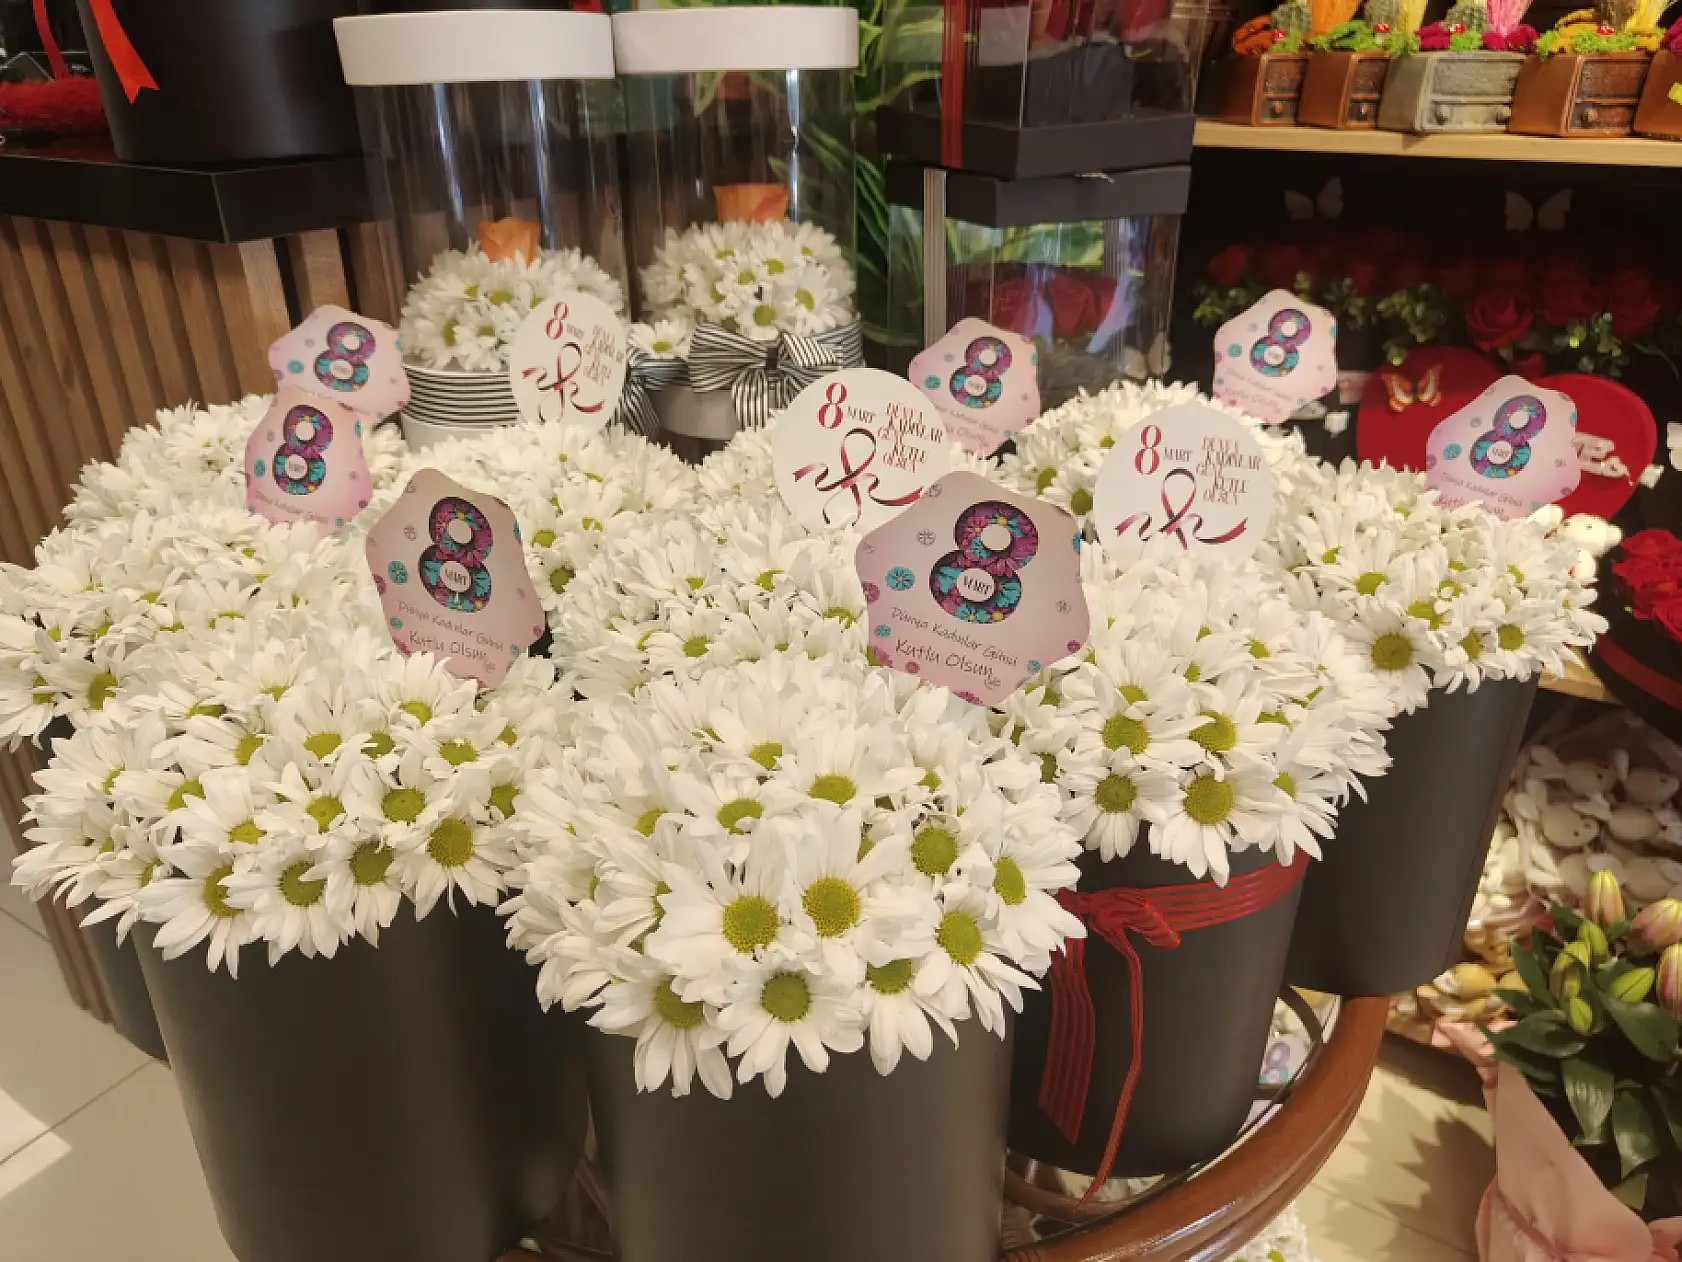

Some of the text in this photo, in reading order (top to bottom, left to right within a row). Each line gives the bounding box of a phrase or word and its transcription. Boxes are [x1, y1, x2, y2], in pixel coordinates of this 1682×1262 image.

[546, 302, 568, 340] 8
[1250, 309, 1311, 377] 8
[313, 321, 376, 393] 8
[950, 336, 1012, 408] 8
[817, 382, 847, 429] 8
[1469, 395, 1546, 479] 8
[272, 404, 333, 495] 8
[1134, 425, 1193, 475] 8 MART
[418, 496, 493, 613] 8
[929, 501, 1038, 624] 8
[963, 575, 992, 595] MART
[409, 630, 488, 662] Kutlu Olsun
[895, 638, 993, 678] Kutlu Olsun
